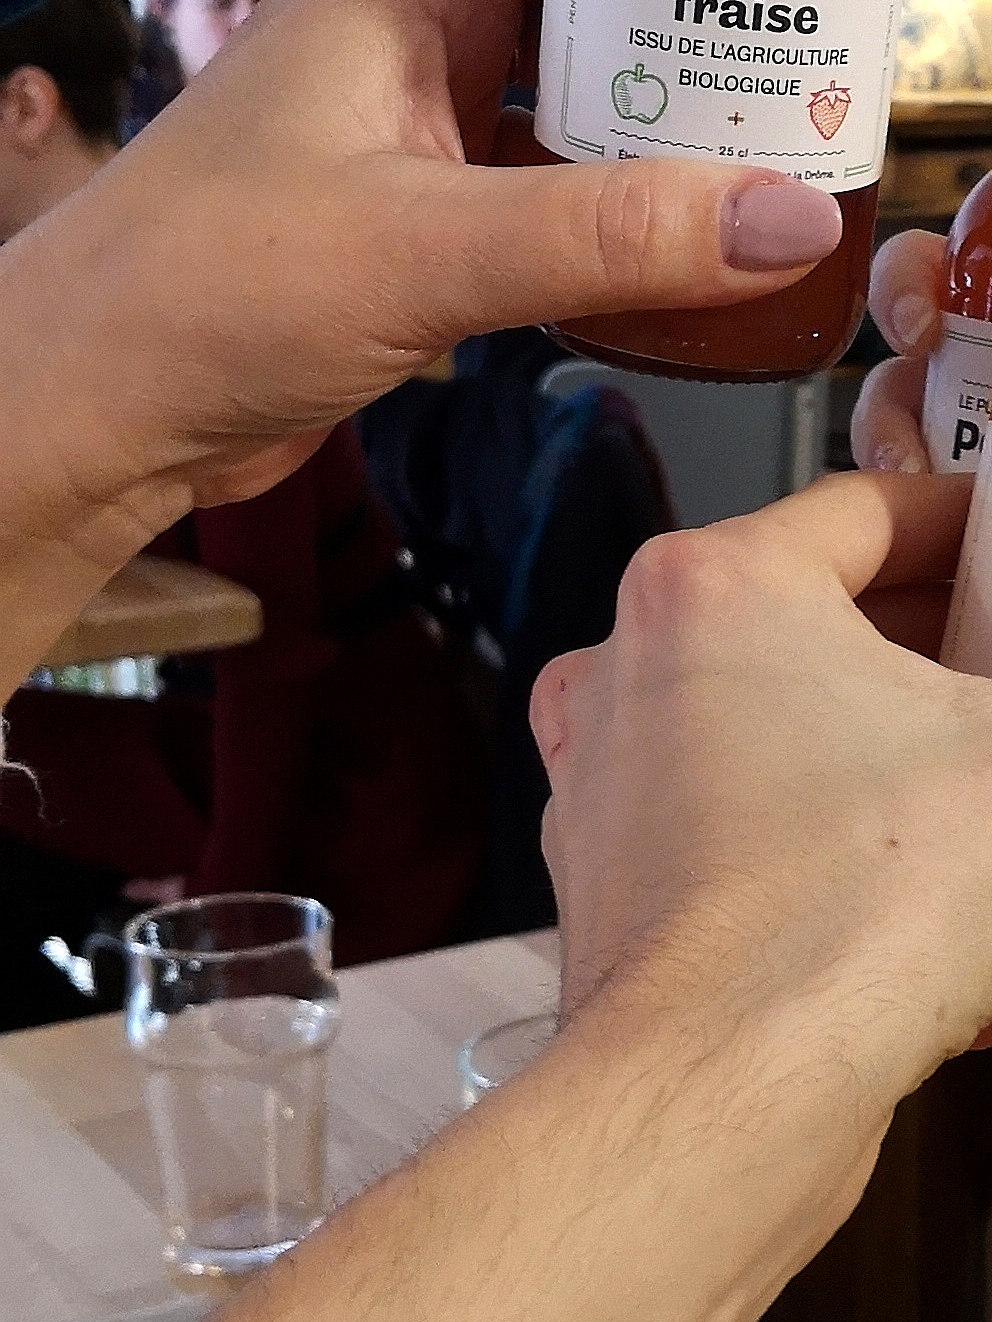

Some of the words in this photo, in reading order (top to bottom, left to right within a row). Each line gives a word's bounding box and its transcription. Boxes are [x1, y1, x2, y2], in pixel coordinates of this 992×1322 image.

[629, 27, 672, 51] ISSU
[678, 37, 705, 57] DE
[710, 41, 849, 66] L'AGRICULTURE
[678, 68, 801, 96] BIOLOGIQUE
[718, 146, 734, 158] 25
[738, 147, 749, 158] cl
